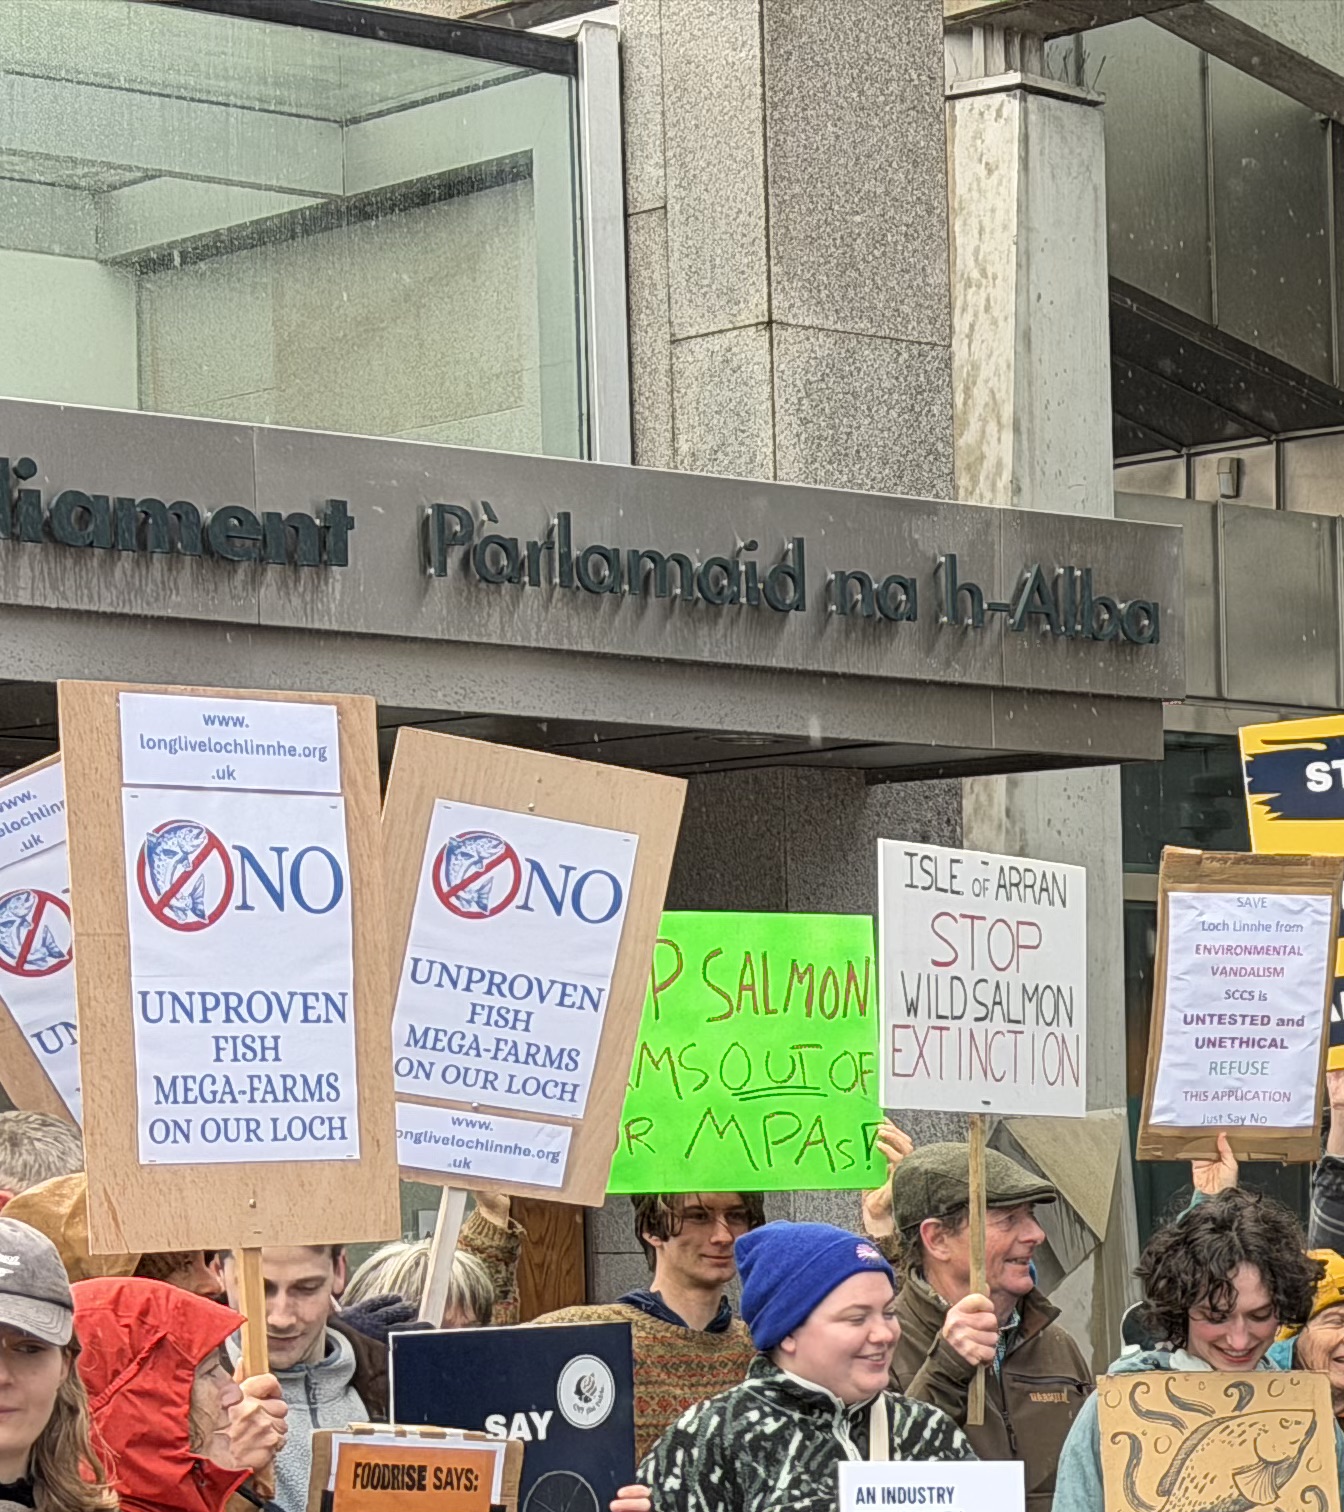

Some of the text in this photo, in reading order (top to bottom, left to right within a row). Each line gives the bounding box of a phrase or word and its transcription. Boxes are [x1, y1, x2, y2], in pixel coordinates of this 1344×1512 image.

[833, 570, 917, 622] na
[943, 552, 1160, 644] h-Alba
[202, 713, 250, 728] www.
[139, 733, 328, 762] longlivelochlinnhe.org
[211, 765, 236, 781] .uk
[232, 845, 344, 914] NO
[515, 857, 623, 924] NO
[904, 850, 1067, 908] ISLE OF ARRAN
[1236, 897, 1268, 909] SAVE
[1201, 920, 1304, 933] Loch Linnhe from
[931, 911, 1042, 974] STOP
[1194, 944, 1303, 957] ENVIRONMENTAL
[409, 957, 606, 1013] UNPROVEN
[701, 947, 871, 1023] SALMON
[1211, 966, 1284, 978] VANDALISM
[138, 990, 348, 1025] UNPROVEN
[900, 970, 1073, 1029] WILD SALMON
[466, 1002, 534, 1032] FISH
[1183, 1013, 1305, 1028] UNTESTED and
[212, 1034, 282, 1062] FISH
[404, 1023, 581, 1072] MEGA-FARMS
[892, 1023, 1080, 1088] EXTINCTION
[1194, 1037, 1289, 1050] UNETHICAL
[394, 1056, 580, 1103] ON OUR LOCH
[719, 1041, 874, 1096] OUT OF
[1208, 1060, 1270, 1076] REFUSE
[153, 1072, 340, 1105] MEGA-FARMS
[1183, 1089, 1292, 1103] THIS APPLICATION
[148, 1115, 348, 1144] ON OUR LOCH
[451, 1115, 494, 1132] www.
[1227, 1113, 1247, 1128] Say
[1250, 1113, 1268, 1125] No
[485, 1411, 553, 1441] SAY
[352, 1461, 479, 1492] FOODRISE SAYS:
[856, 1486, 955, 1505] AN INDUSTRY
